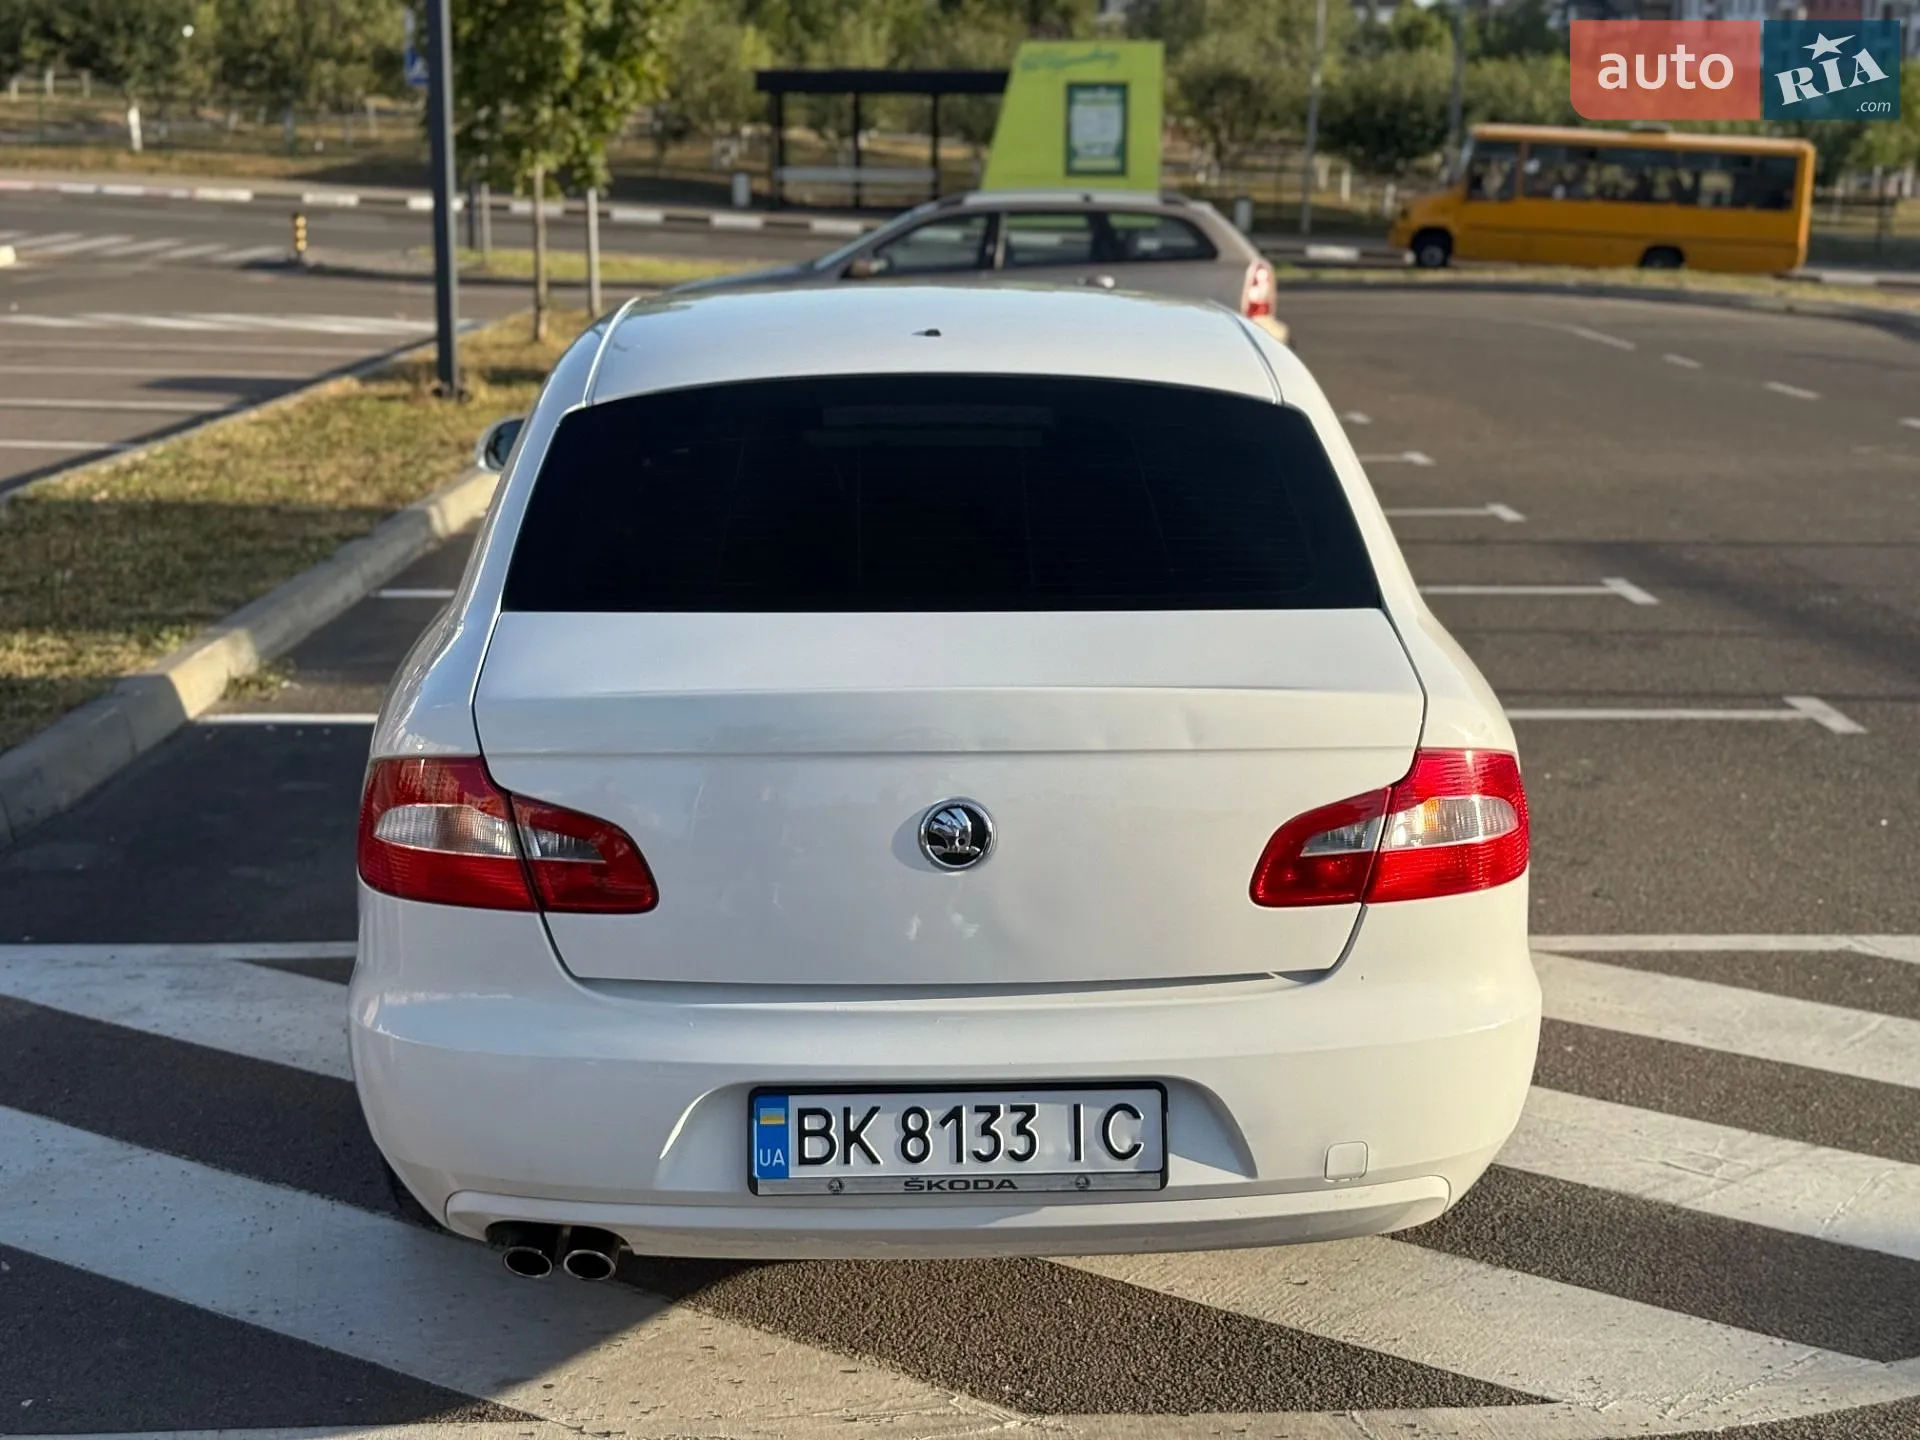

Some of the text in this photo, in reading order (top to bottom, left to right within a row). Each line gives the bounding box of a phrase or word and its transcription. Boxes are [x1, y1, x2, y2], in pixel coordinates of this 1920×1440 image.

[796, 1103, 1145, 1166] BK 8133 IC
[759, 1148, 785, 1167] UA
[903, 1176, 1019, 1192] ŠKODA
